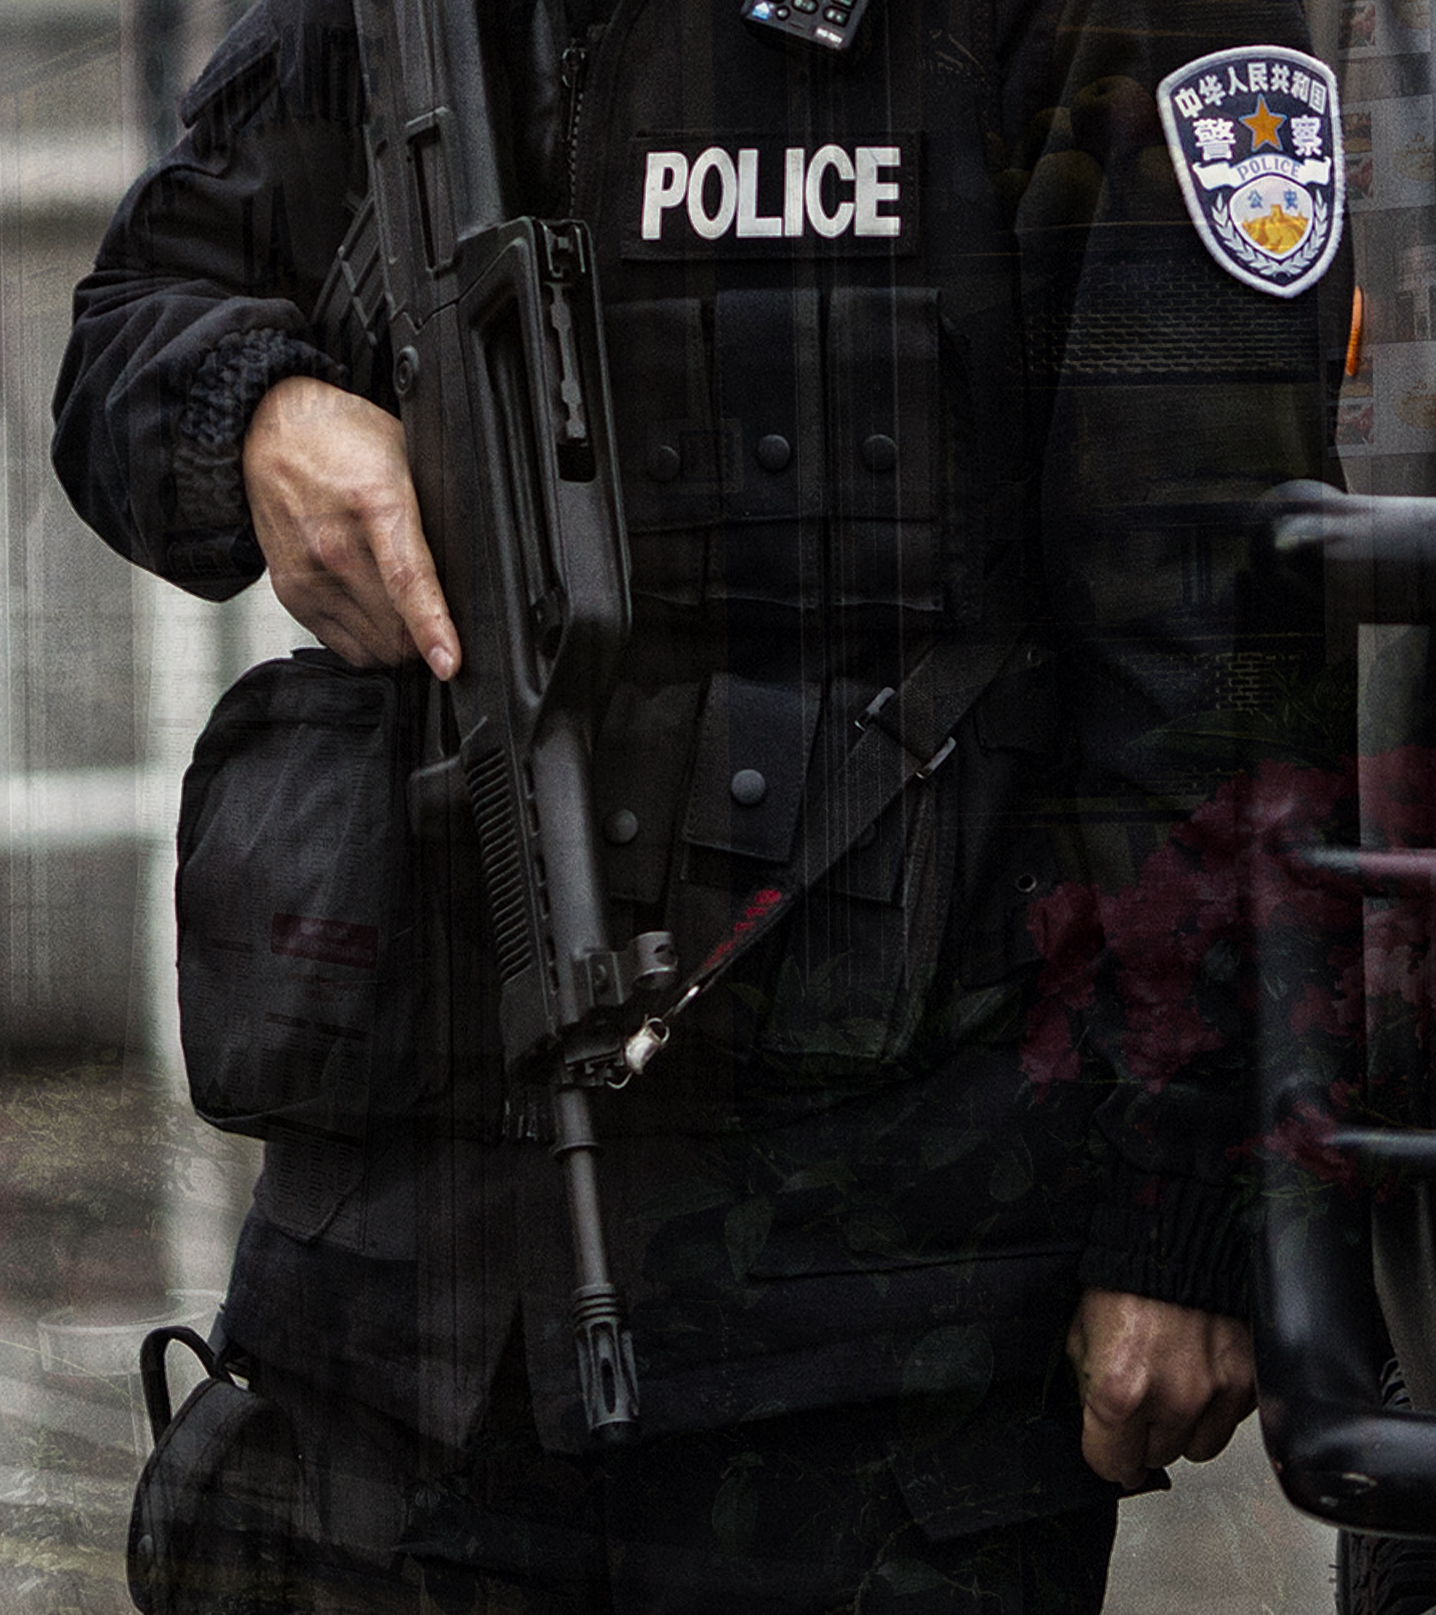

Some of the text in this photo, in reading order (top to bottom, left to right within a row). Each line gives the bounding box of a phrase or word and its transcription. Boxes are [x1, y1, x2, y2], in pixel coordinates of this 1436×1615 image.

[1174, 62, 1327, 118] 中华人民共和国
[641, 144, 901, 240] POLICE
[1236, 157, 1301, 181] POLICE
